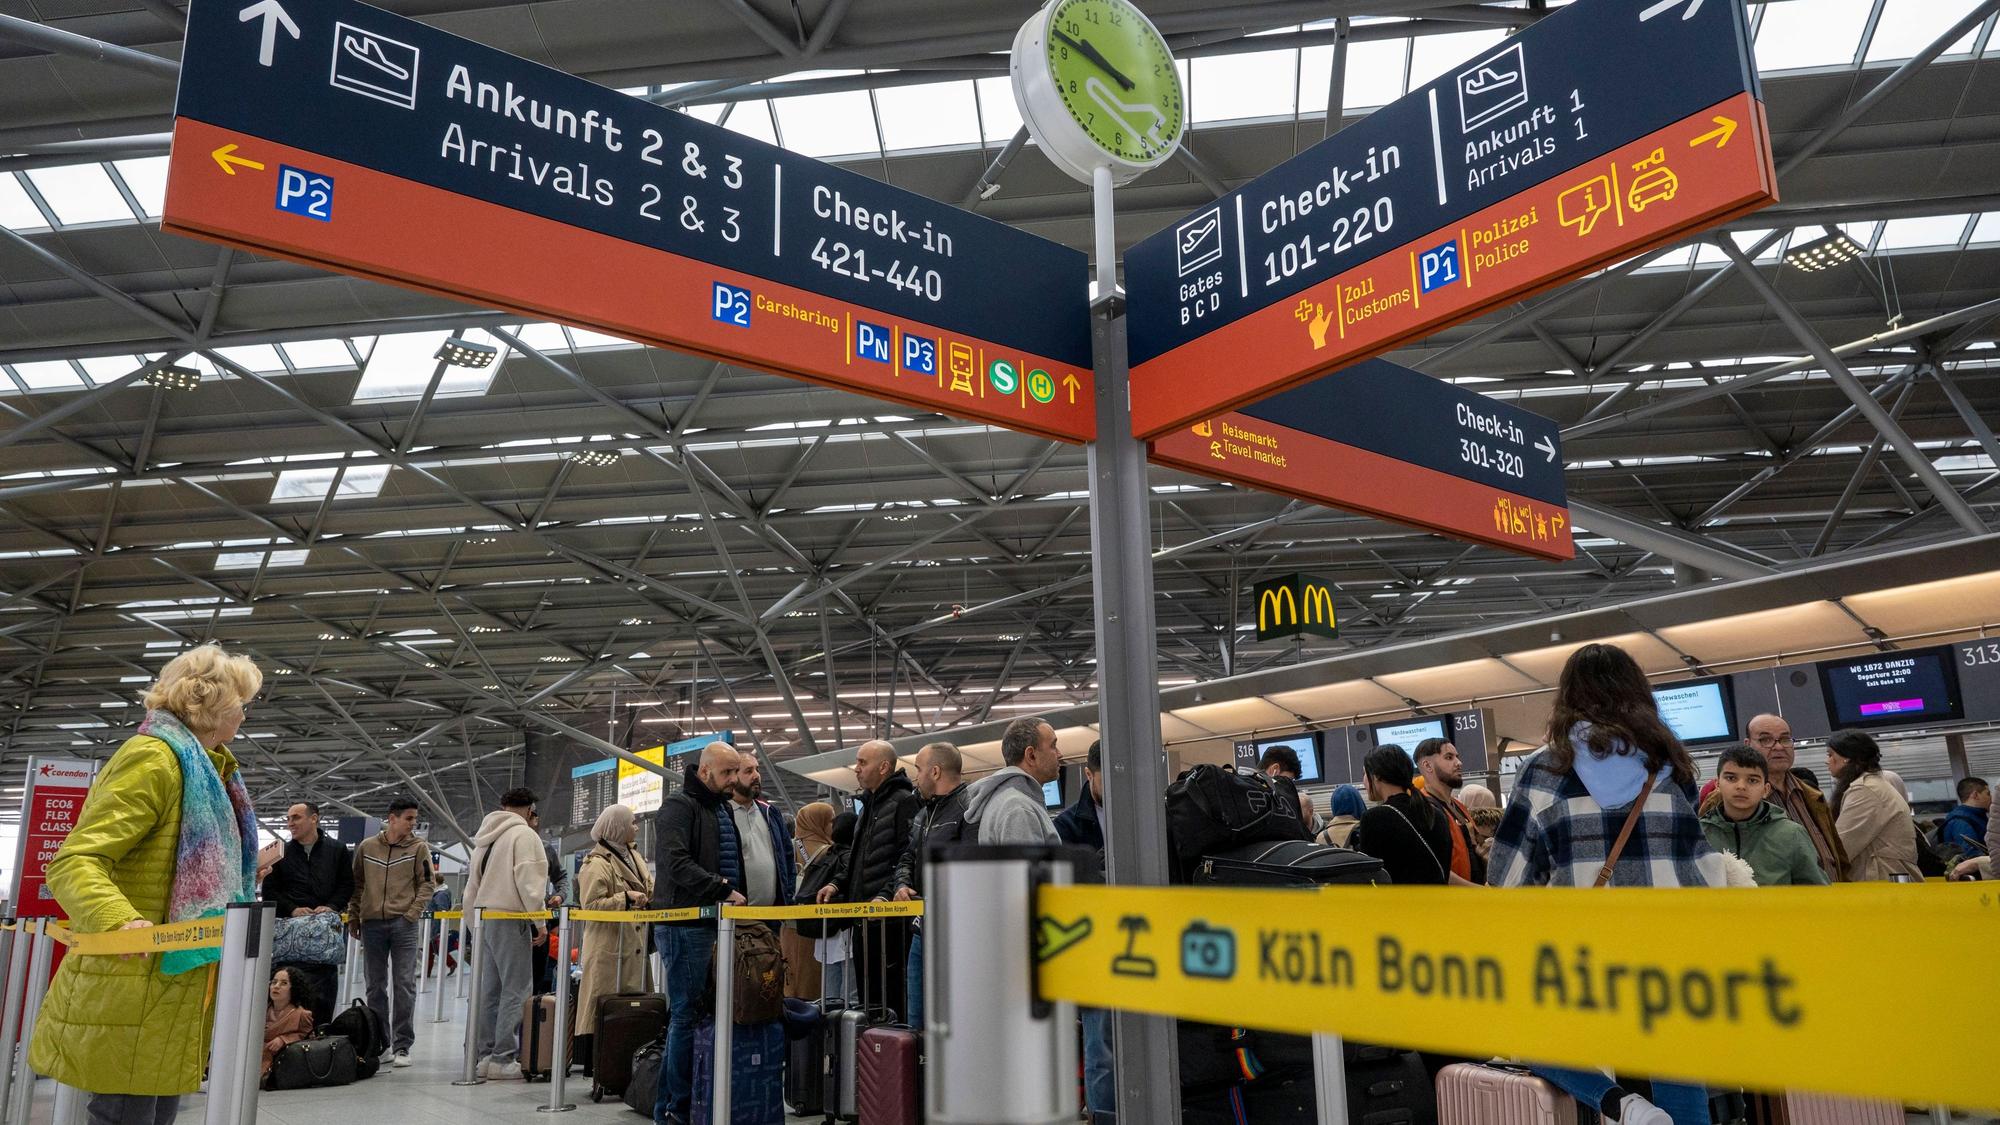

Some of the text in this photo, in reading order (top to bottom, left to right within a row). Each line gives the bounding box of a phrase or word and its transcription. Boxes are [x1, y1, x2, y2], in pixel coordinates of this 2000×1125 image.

[1066, 21, 1080, 36] 10
[1086, 9, 1099, 25] 11
[1109, 11, 1121, 27] 12
[1060, 47, 1068, 60] 9
[1154, 64, 1161, 77] 2
[1070, 80, 1077, 94] 8
[1162, 94, 1169, 108] 3
[446, 64, 743, 190] Ankunft 2 & 3
[1087, 112, 1094, 125] 7
[1465, 89, 1585, 165] Ankunft 1
[1115, 132, 1122, 145] 6
[1140, 135, 1147, 149] 5
[1466, 118, 1589, 191] Arrivals 1
[441, 122, 741, 243] Arrivals 2 & 3
[1261, 143, 1401, 235] Check-in
[812, 185, 953, 258] Check-in
[1472, 206, 1539, 247] Polizei
[1264, 196, 1394, 287] 101-220
[1474, 238, 1530, 273] Police
[811, 237, 943, 302] 421-440
[1179, 271, 1223, 302] Gates
[1344, 277, 1374, 304] Zoll
[756, 294, 839, 333] Carsharing
[1180, 293, 1220, 326] B C D
[1345, 289, 1411, 325] Customs
[994, 361, 1014, 392] S
[1035, 376, 1047, 396] H
[1221, 422, 1278, 449] Reisemarkt
[1456, 402, 1524, 446] Check-in
[1223, 439, 1287, 468] Travel market
[1460, 438, 1524, 479] 301-320
[1497, 497, 1508, 509] WC
[1519, 506, 1529, 518] WC
[1849, 665, 1862, 674] W6
[1885, 658, 1915, 669] DANZIG
[1962, 643, 2000, 666] 313
[1857, 671, 1891, 681] Departure
[1454, 714, 1478, 731] 315
[1237, 744, 1254, 758] 316
[52, 768, 88, 778] corendon
[45, 799, 74, 809] ECO&
[45, 810, 71, 820] FLEX
[40, 822, 73, 832] CLASS
[1258, 931, 1803, 1032] Köln Bonn Airport
